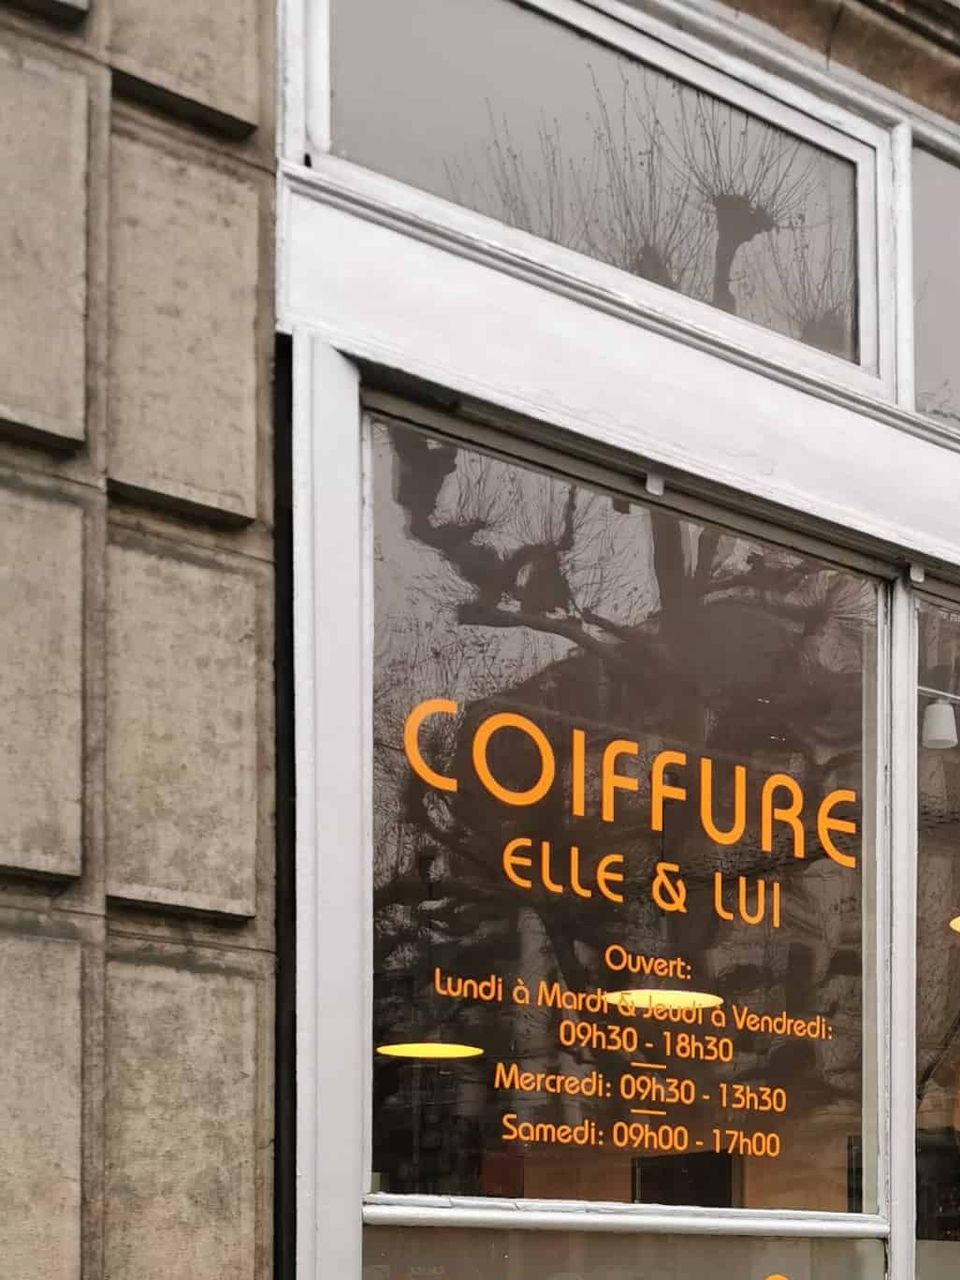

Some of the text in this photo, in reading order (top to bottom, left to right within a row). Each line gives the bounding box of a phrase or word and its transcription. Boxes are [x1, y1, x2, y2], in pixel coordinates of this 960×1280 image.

[404, 698, 857, 868] COIFFURE
[502, 837, 781, 928] ELLE & LUI
[604, 944, 690, 980] Ouvert:
[434, 967, 833, 1040] Lundi à Mardi & Jeudi à Vendredi:
[559, 1019, 638, 1053] 09h30
[663, 1031, 734, 1063] 18h30
[494, 1062, 611, 1097] Mercredi:
[620, 1073, 696, 1105] 09h30
[719, 1083, 787, 1113] 13h30
[502, 1113, 604, 1146] Samedi:
[612, 1121, 689, 1152] 09h00
[712, 1128, 781, 1158] 17h00
